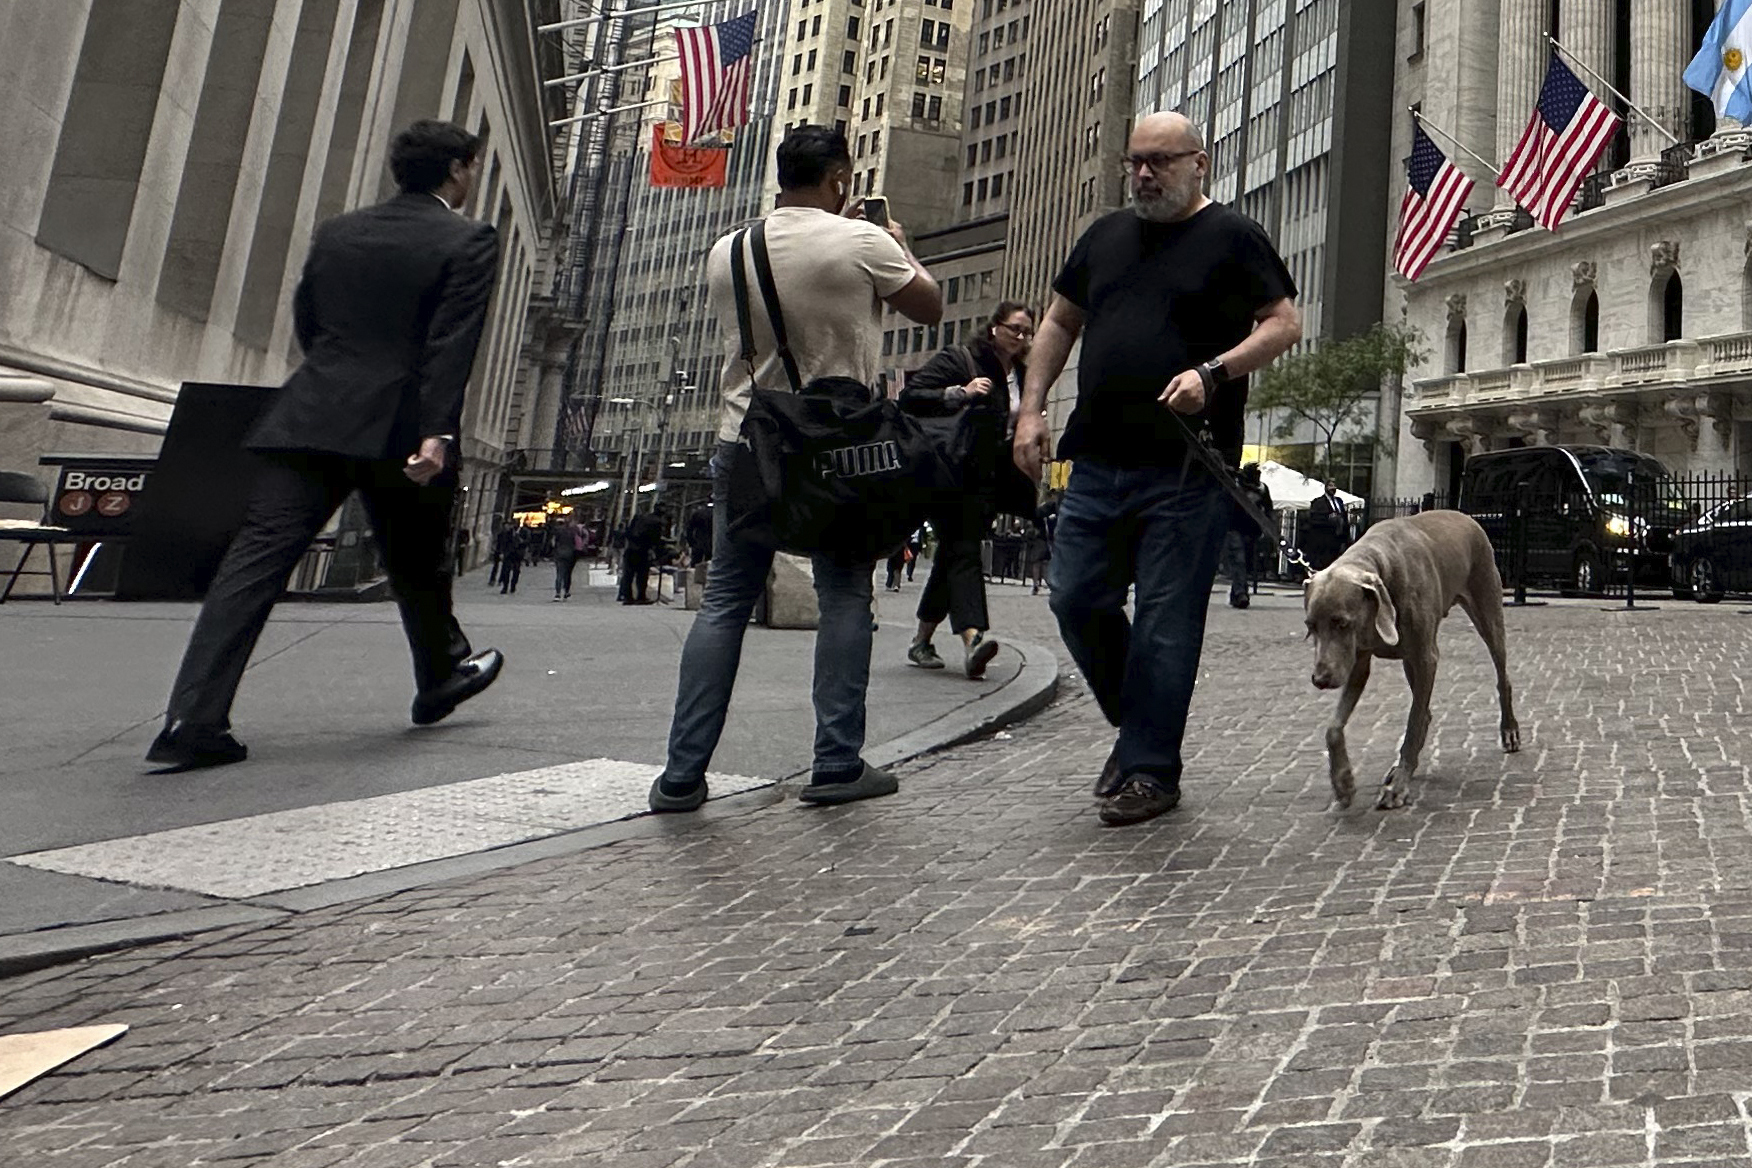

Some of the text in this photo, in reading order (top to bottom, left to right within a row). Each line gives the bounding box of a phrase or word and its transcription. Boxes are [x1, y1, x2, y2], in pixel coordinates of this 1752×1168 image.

[812, 440, 902, 479] PUMA
[64, 472, 146, 492] Broad
[70, 496, 123, 511] J Z
